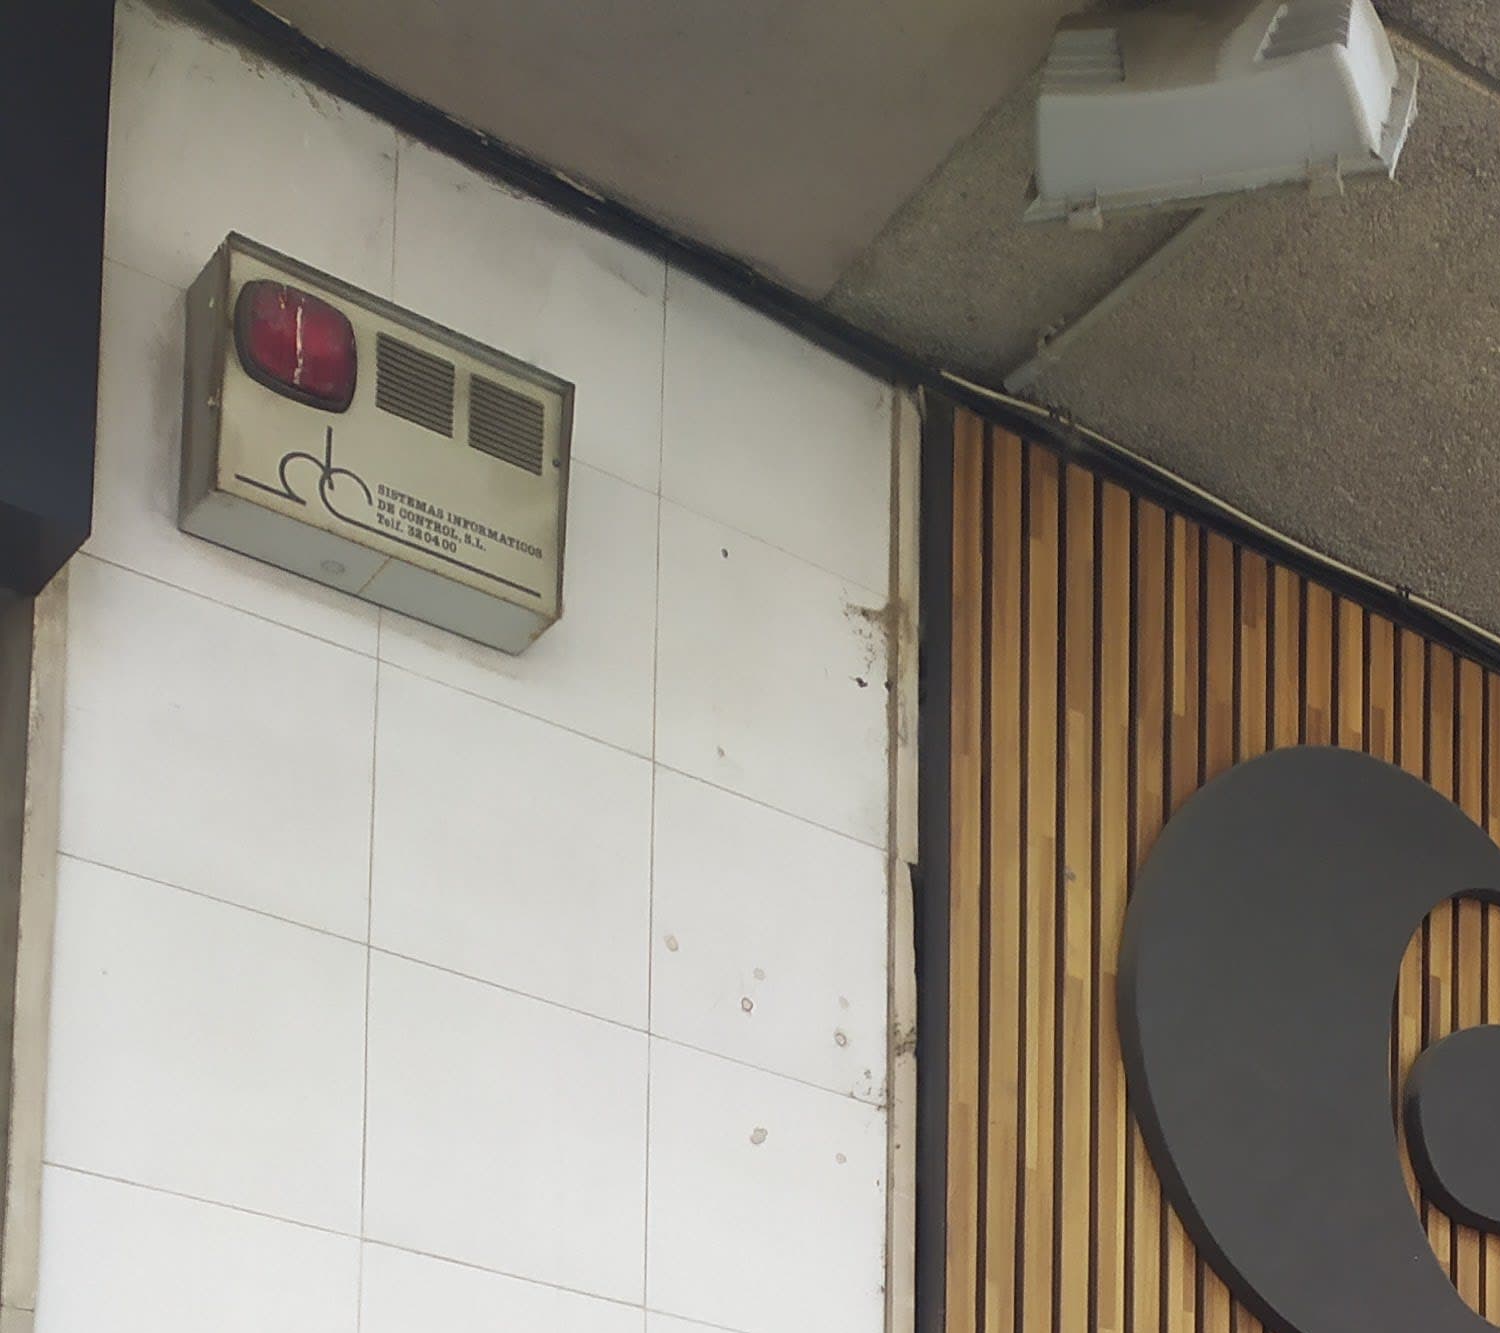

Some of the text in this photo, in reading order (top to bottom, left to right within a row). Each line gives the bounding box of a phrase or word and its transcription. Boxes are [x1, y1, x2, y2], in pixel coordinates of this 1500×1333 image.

[376, 513, 404, 533] Telf.
[377, 484, 543, 560] SISTEMAS INFORMATICOS
[377, 499, 487, 552] DE CONTROL, S.L.
